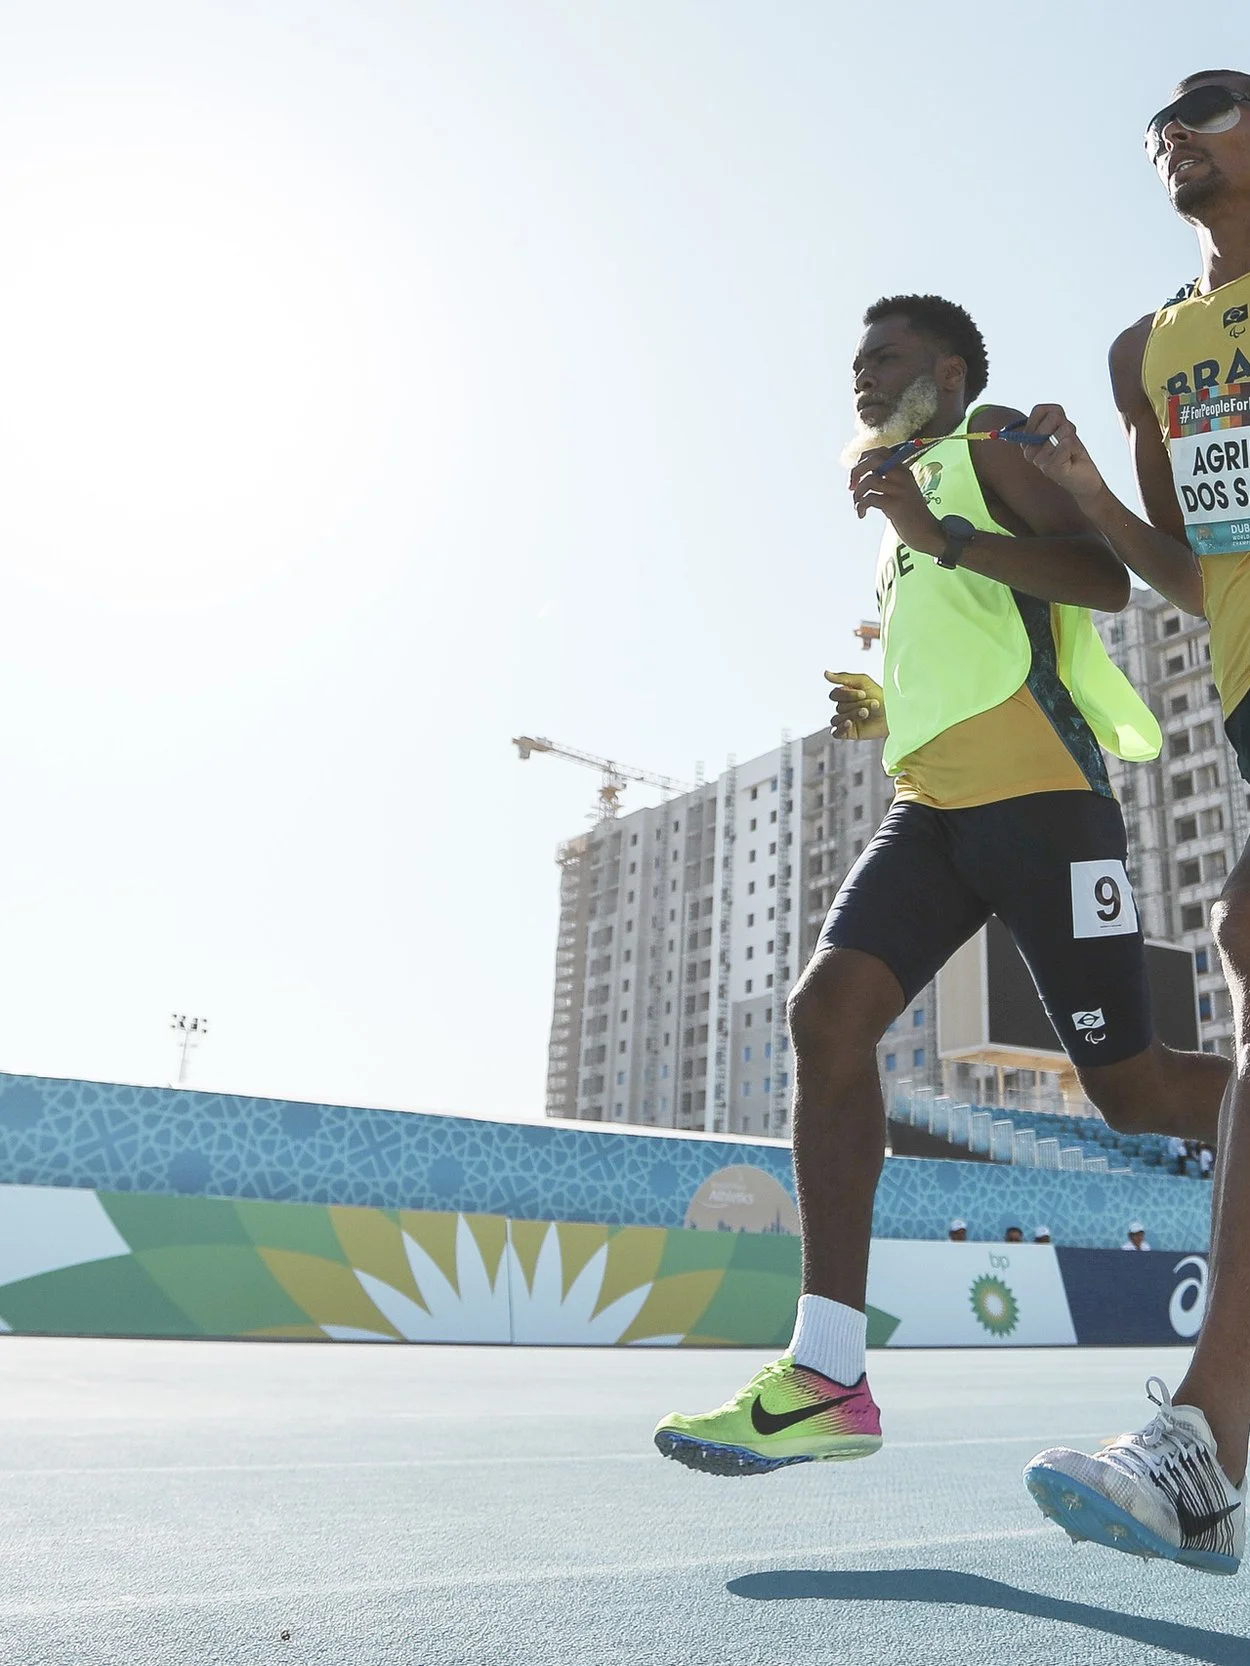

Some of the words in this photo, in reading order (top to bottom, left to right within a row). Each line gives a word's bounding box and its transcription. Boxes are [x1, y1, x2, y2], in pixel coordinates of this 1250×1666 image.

[1180, 480, 1229, 513] DOS
[1094, 876, 1121, 922] 9
[989, 1251, 1010, 1271] bp
